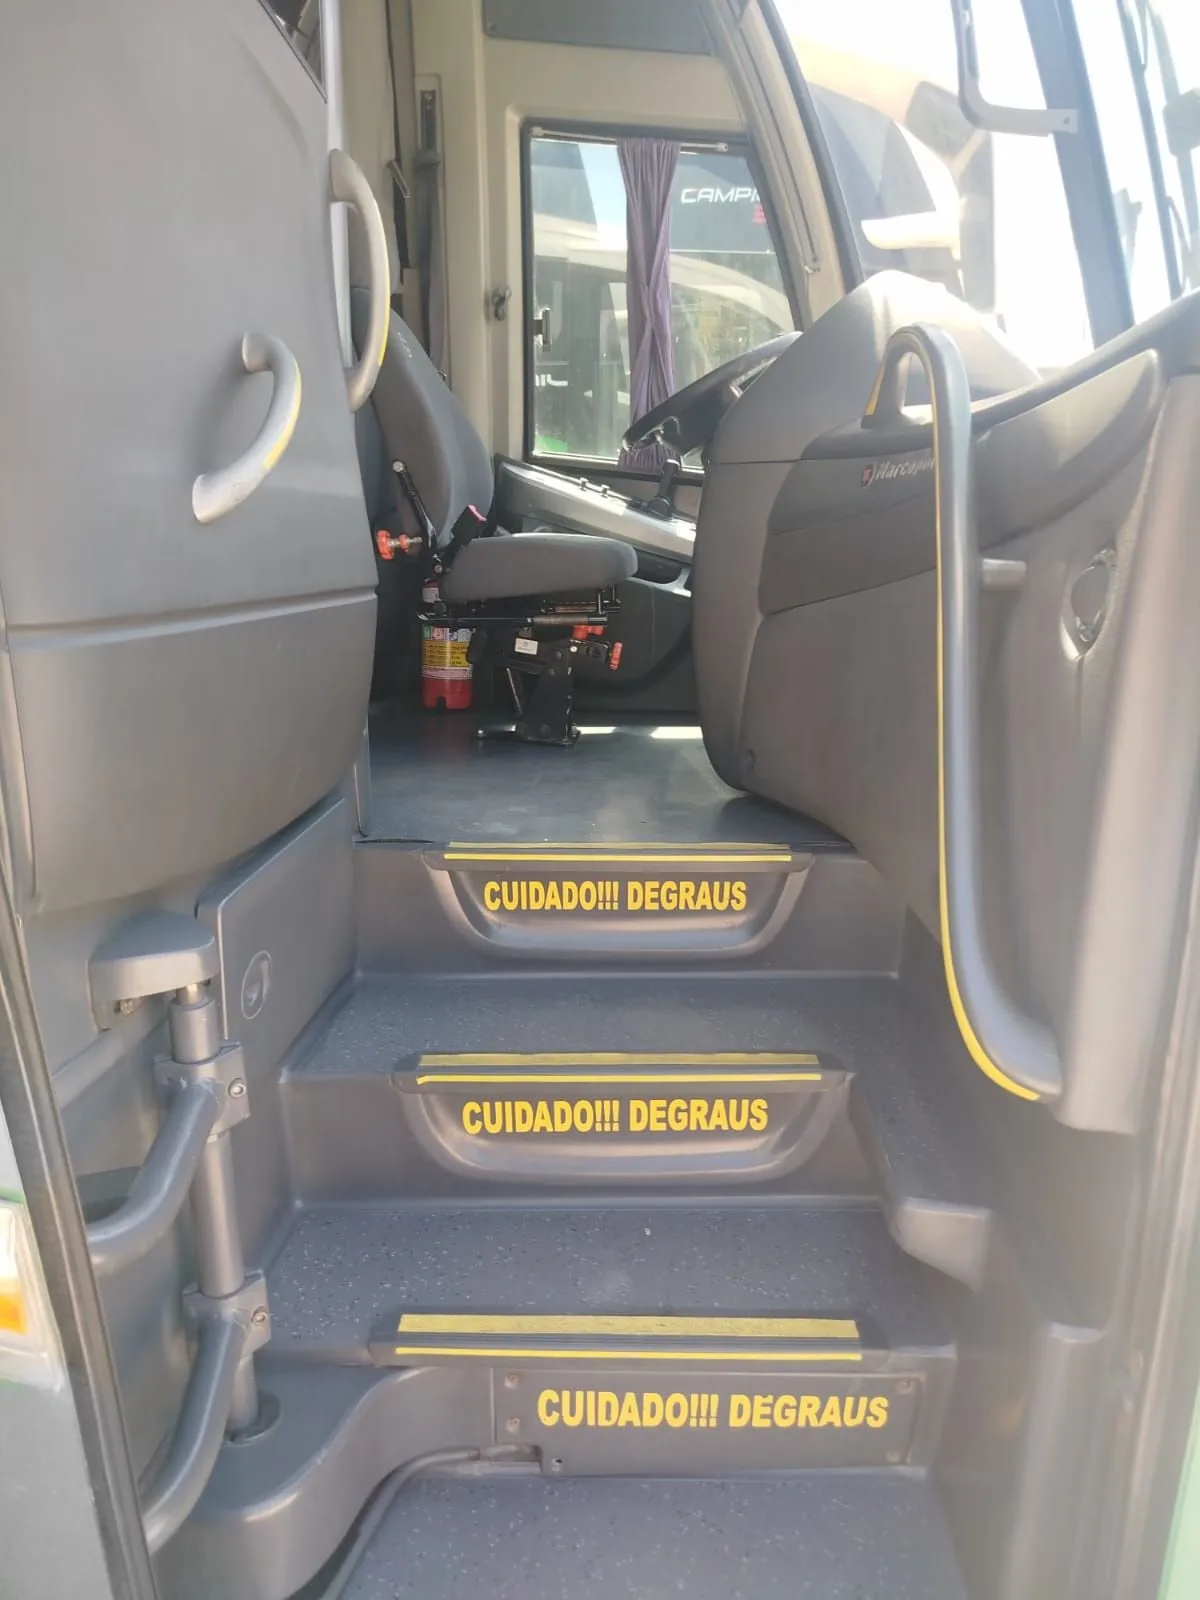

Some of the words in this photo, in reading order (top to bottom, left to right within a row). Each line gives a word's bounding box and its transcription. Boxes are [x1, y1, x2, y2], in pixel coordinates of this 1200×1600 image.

[484, 880, 619, 912] CUIDADO!!!
[627, 880, 747, 912] DEGRAUS
[461, 1098, 620, 1135] CUIDADO!!!
[628, 1097, 768, 1133] DEGRAUS
[537, 1389, 718, 1428] CUIDADO!!!
[729, 1394, 889, 1428] DEGRAUS
